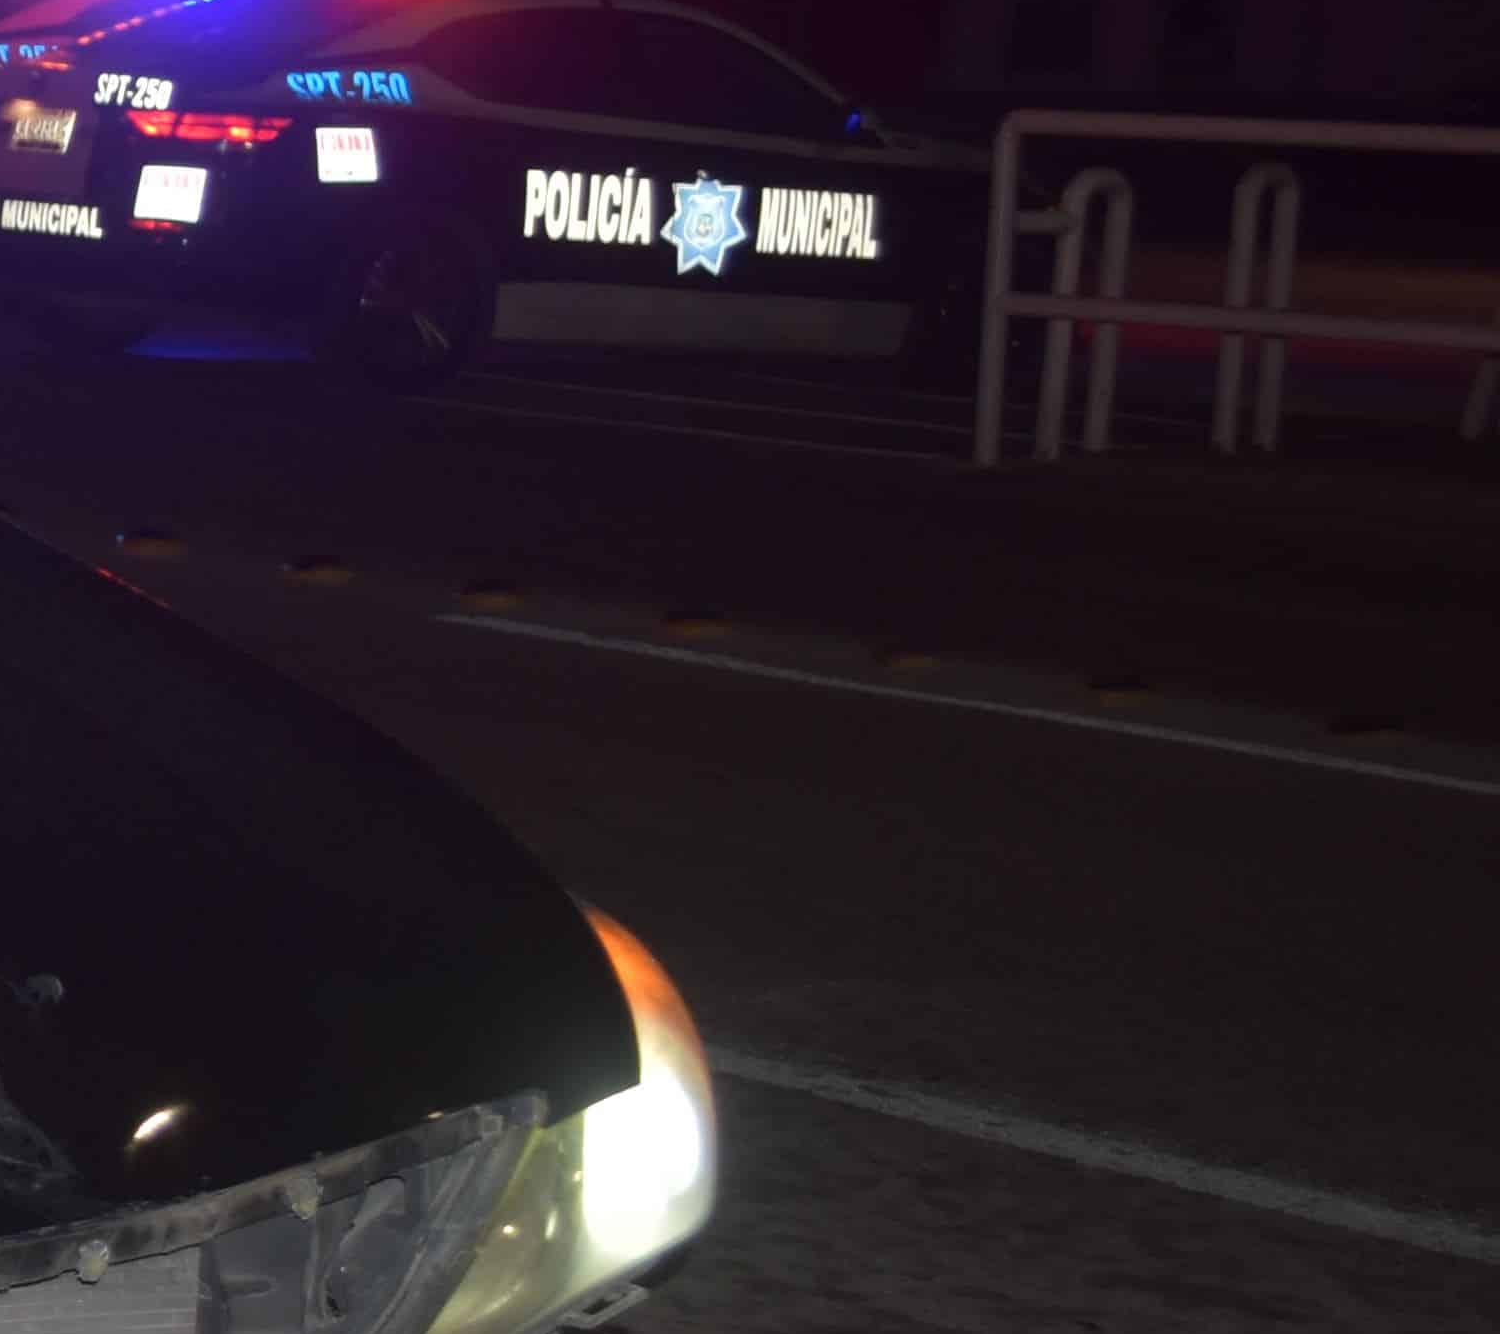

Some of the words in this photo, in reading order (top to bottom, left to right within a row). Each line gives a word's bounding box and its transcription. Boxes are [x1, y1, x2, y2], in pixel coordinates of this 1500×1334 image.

[94, 73, 172, 110] SPT-250
[1, 199, 102, 239] MUNICIPAL
[524, 168, 651, 245] POLICÍA
[756, 187, 877, 259] MUNICIPAL
